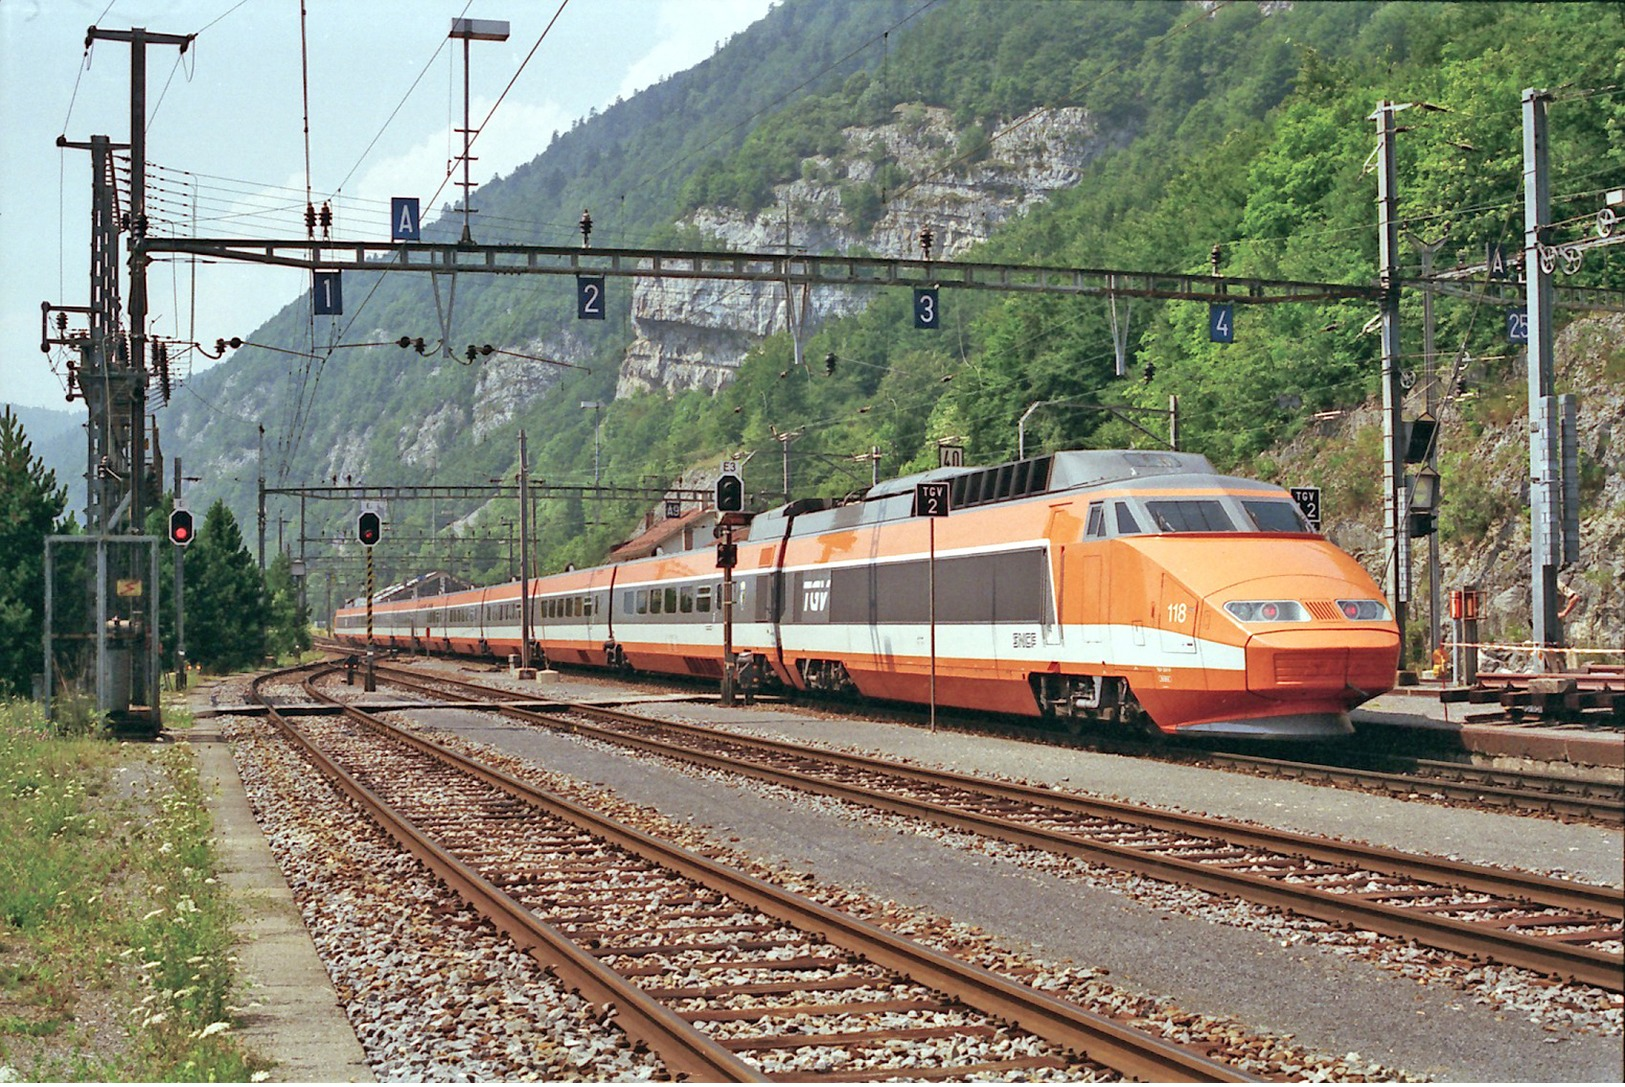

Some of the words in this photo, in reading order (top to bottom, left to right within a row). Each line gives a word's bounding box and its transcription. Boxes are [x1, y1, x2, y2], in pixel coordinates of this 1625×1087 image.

[399, 204, 413, 232] A
[1493, 251, 1504, 274] A
[324, 279, 330, 307] 1
[584, 284, 599, 312] 2
[920, 295, 933, 322] 3
[1216, 310, 1228, 336] 4
[1509, 313, 1528, 338] 25
[723, 462, 736, 472] E3
[923, 487, 943, 497] TGV
[1296, 491, 1314, 501] TGV
[928, 498, 938, 514] 2
[803, 579, 831, 611] TGV
[1167, 603, 1187, 623] 118
[1013, 632, 1036, 648] SNCF
